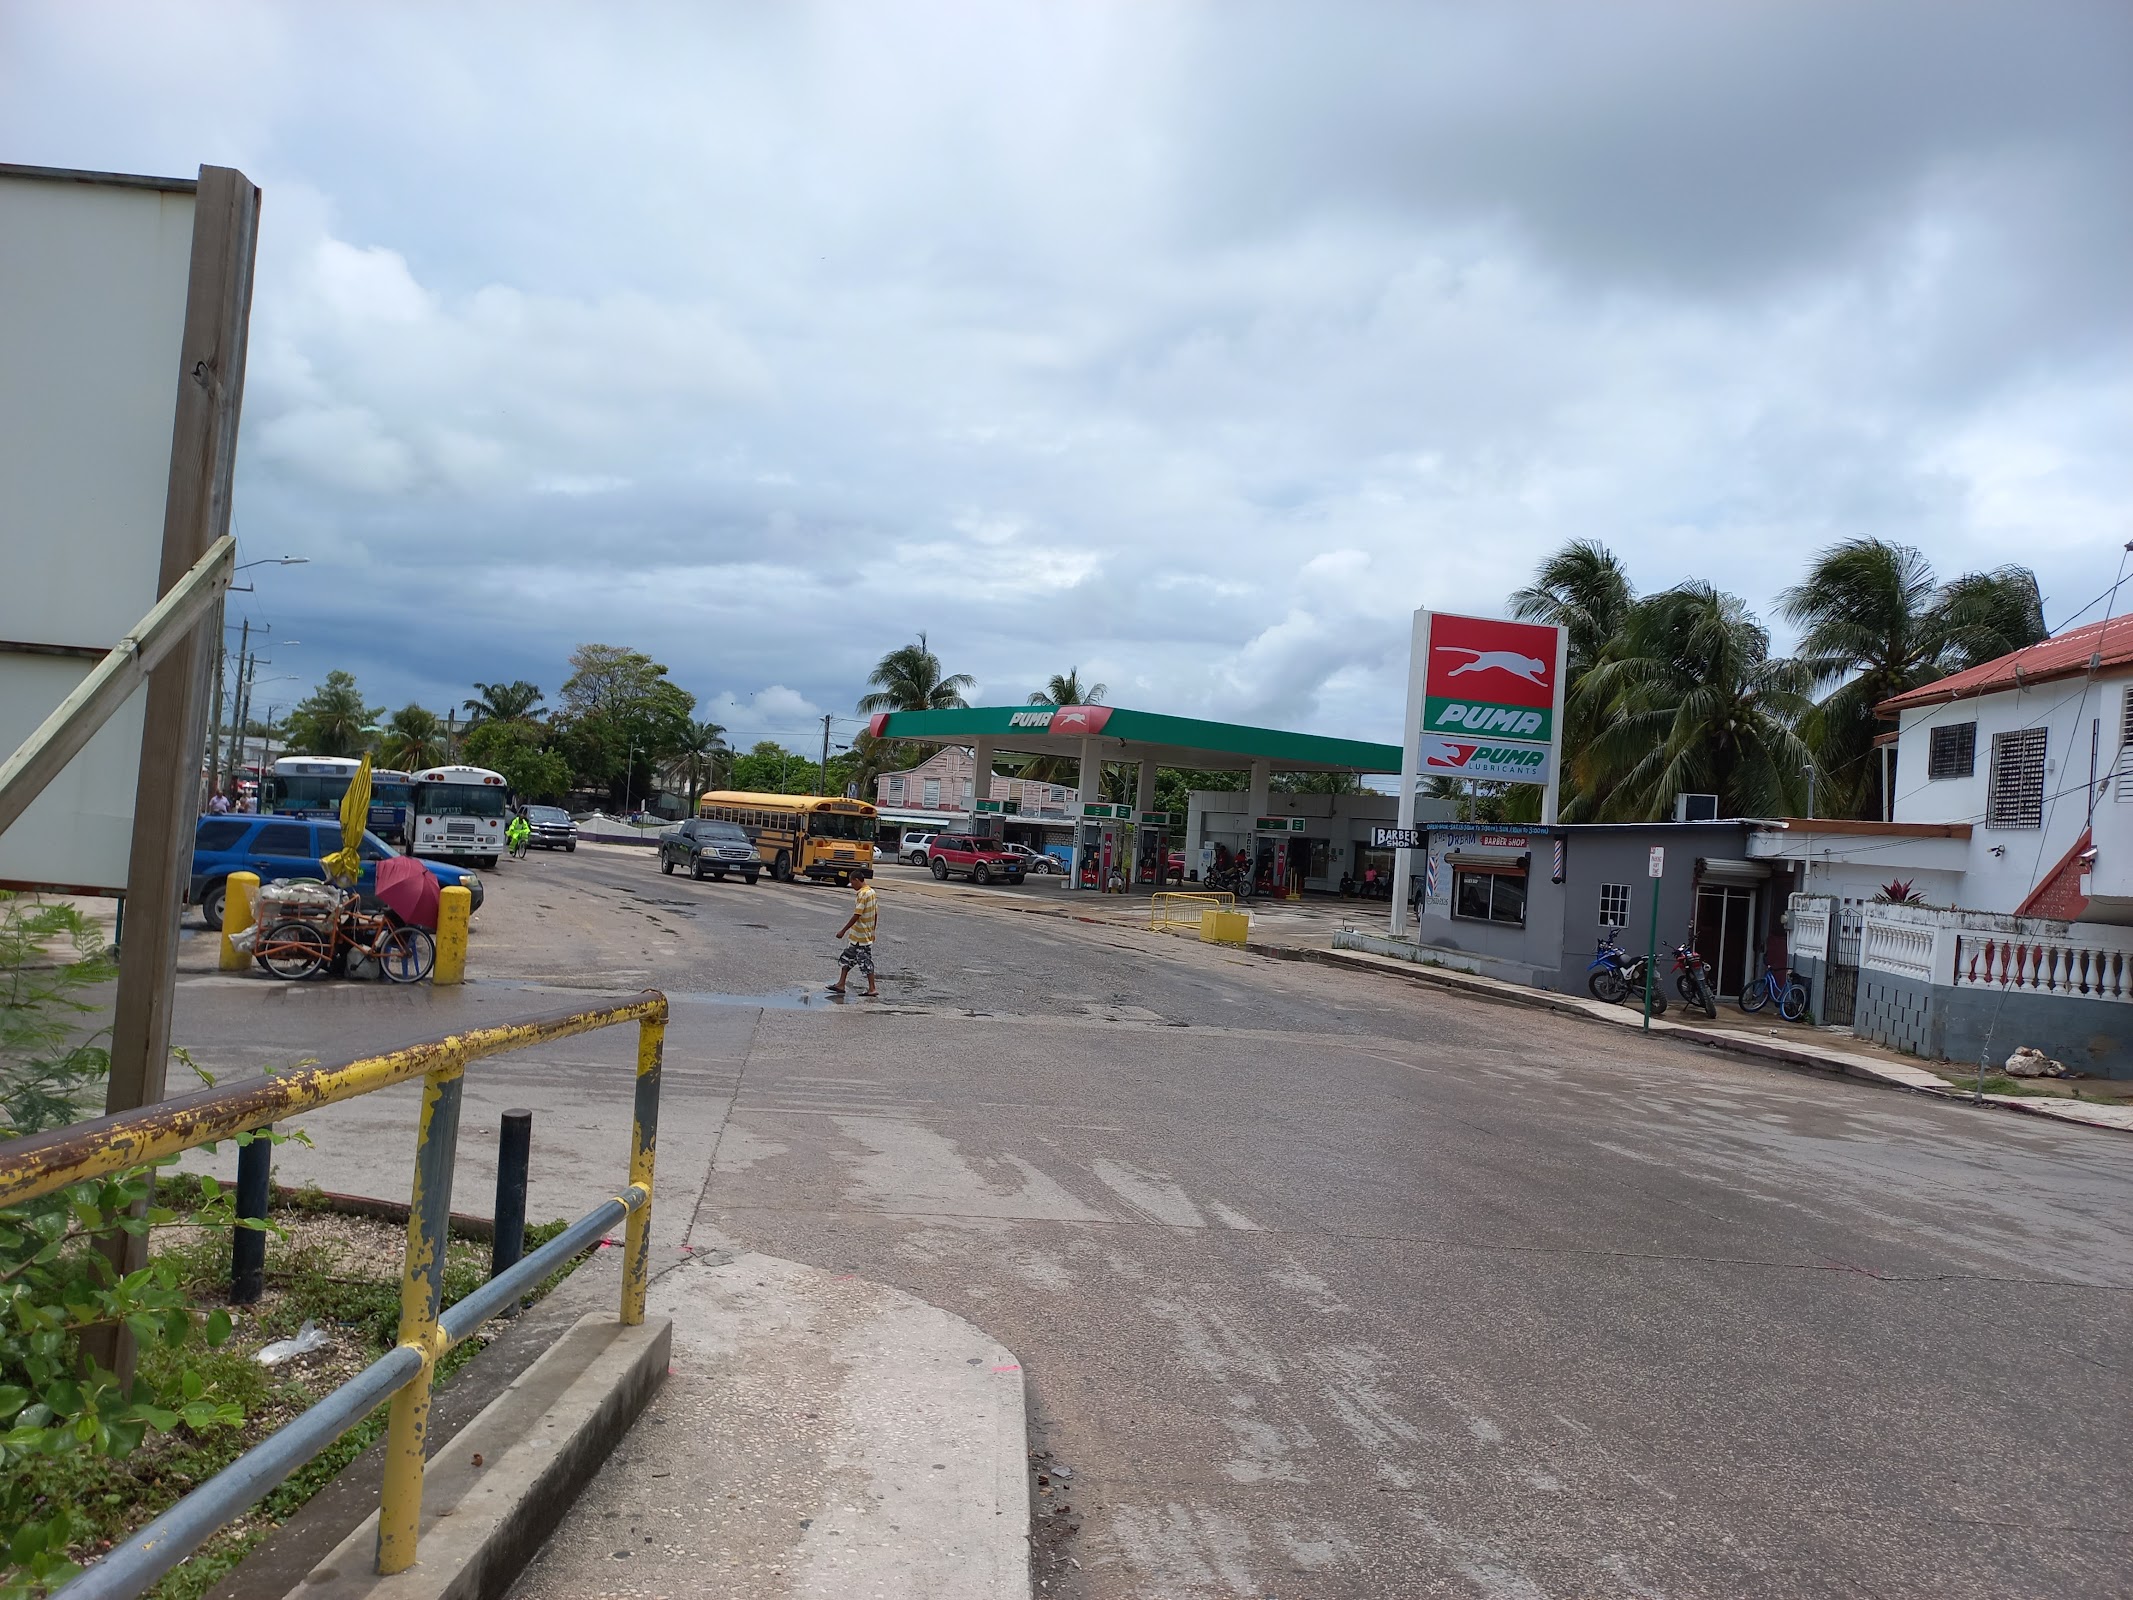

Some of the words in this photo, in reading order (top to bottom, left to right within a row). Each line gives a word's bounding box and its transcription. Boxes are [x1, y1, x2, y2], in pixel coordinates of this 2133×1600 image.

[1008, 712, 1055, 727] PUMA
[1435, 703, 1543, 735] PUMA
[1469, 746, 1545, 767] PUMA
[1468, 764, 1537, 775] LUBRICANTS
[1377, 828, 1420, 846] BARBER
[1386, 840, 1410, 848] SHOP
[1446, 832, 1476, 847] DREAM
[1484, 836, 1508, 846] BARBER
[1508, 838, 1526, 847] SHOP
